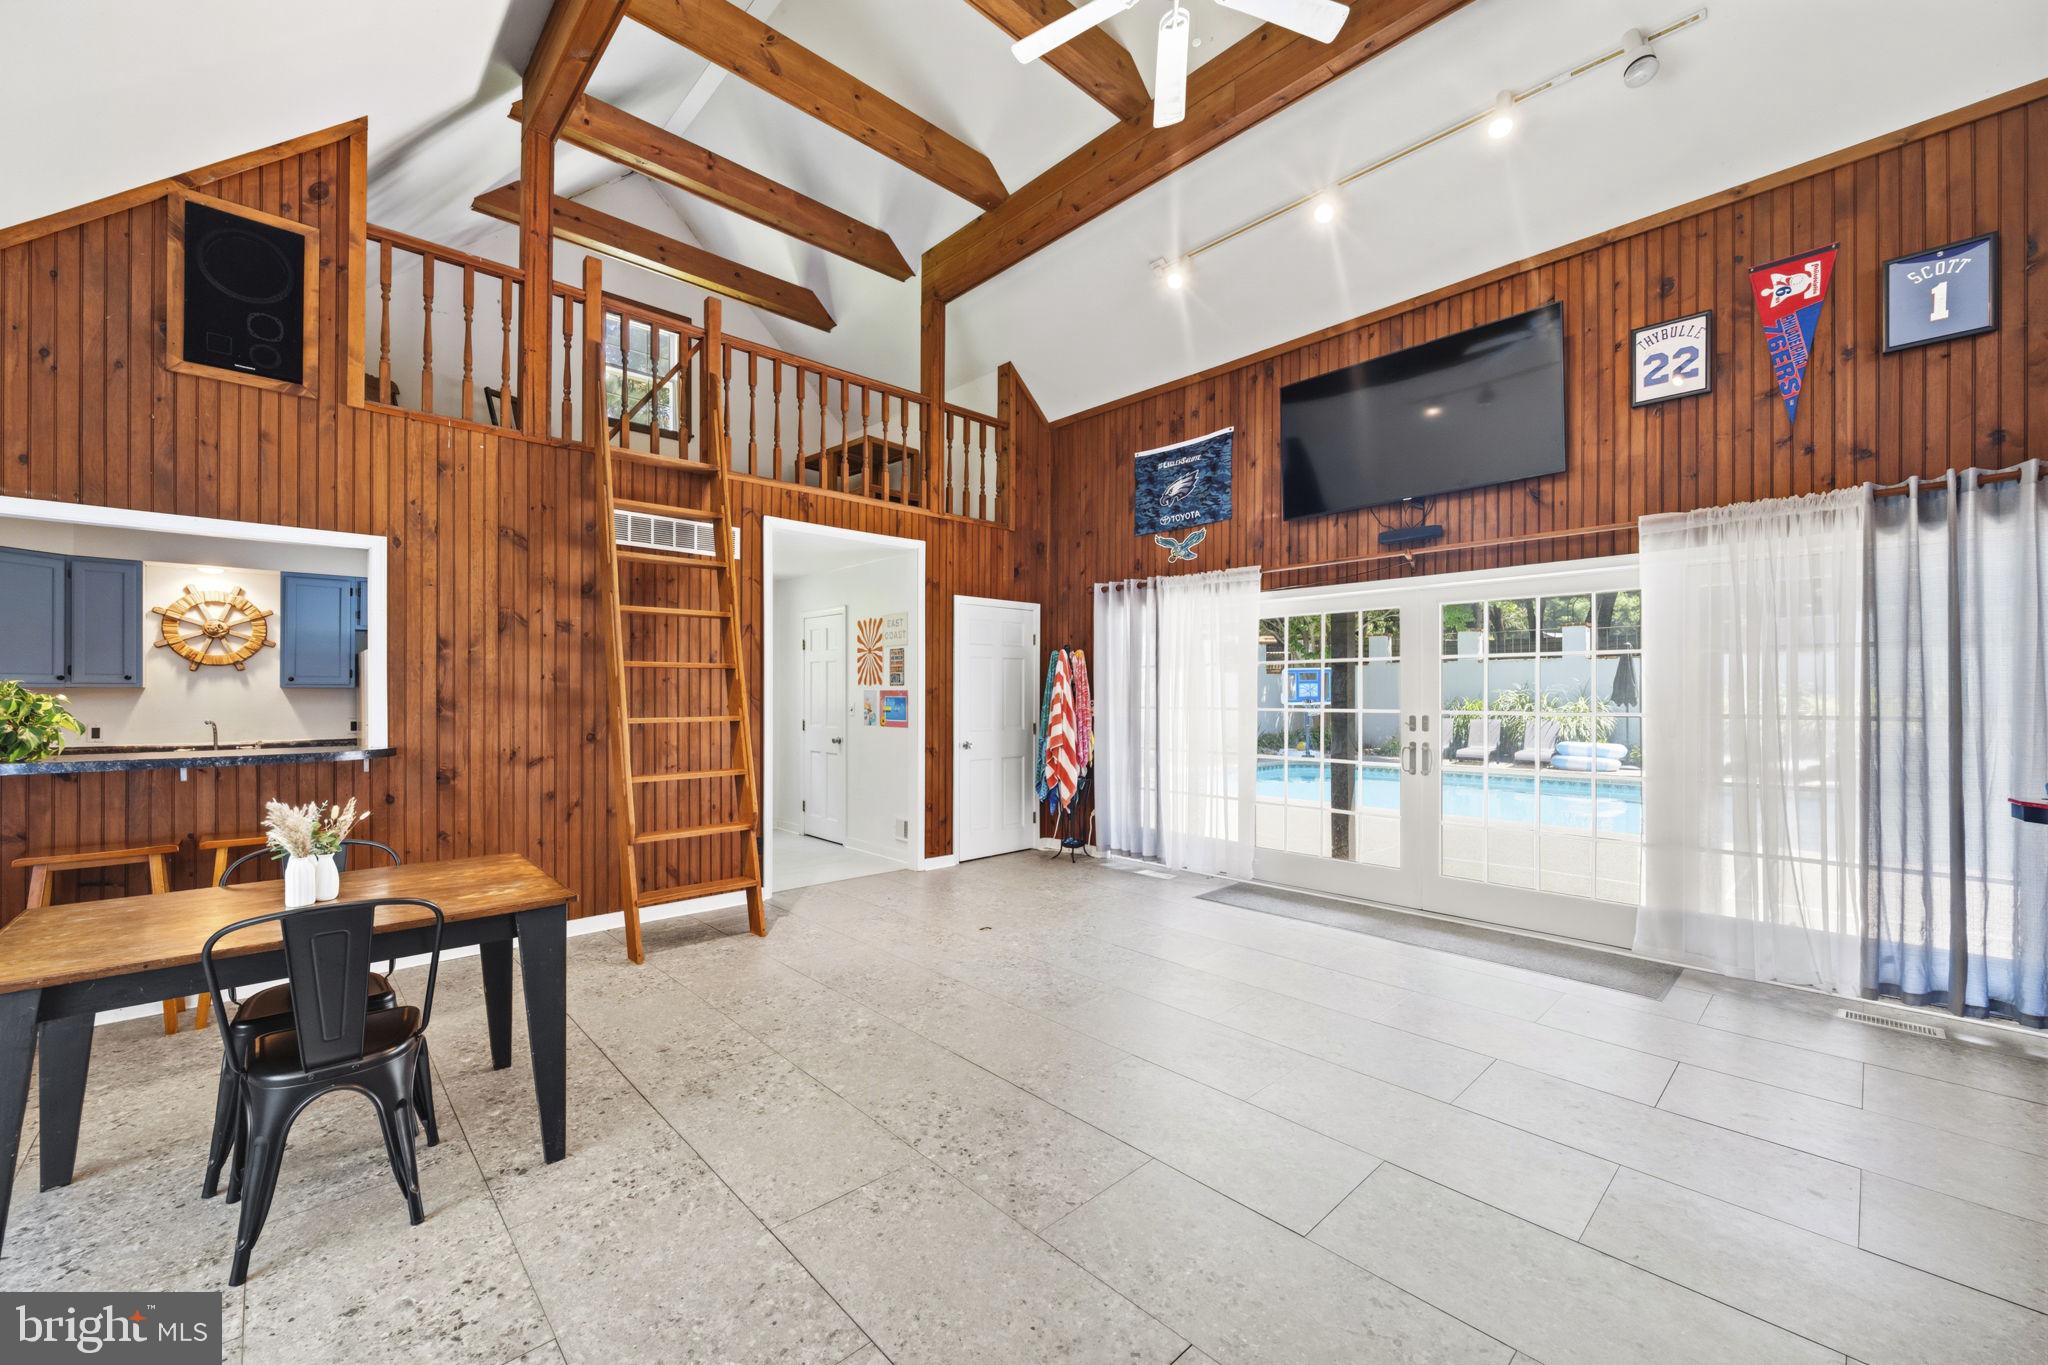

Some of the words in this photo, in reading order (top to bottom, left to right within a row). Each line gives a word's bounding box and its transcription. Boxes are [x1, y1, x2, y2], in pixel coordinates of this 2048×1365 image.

[1907, 258, 1972, 284] SCOTT
[1930, 281, 1949, 321] 1
[1636, 325, 1706, 350] THYBULLE
[1781, 313, 1808, 369] PHILADELPHIA
[1643, 345, 1700, 388] 22
[1763, 319, 1801, 397] 76ERS
[1170, 510, 1201, 522] TOYOTA
[885, 630, 907, 640] COAST
[887, 618, 904, 628] EAST
